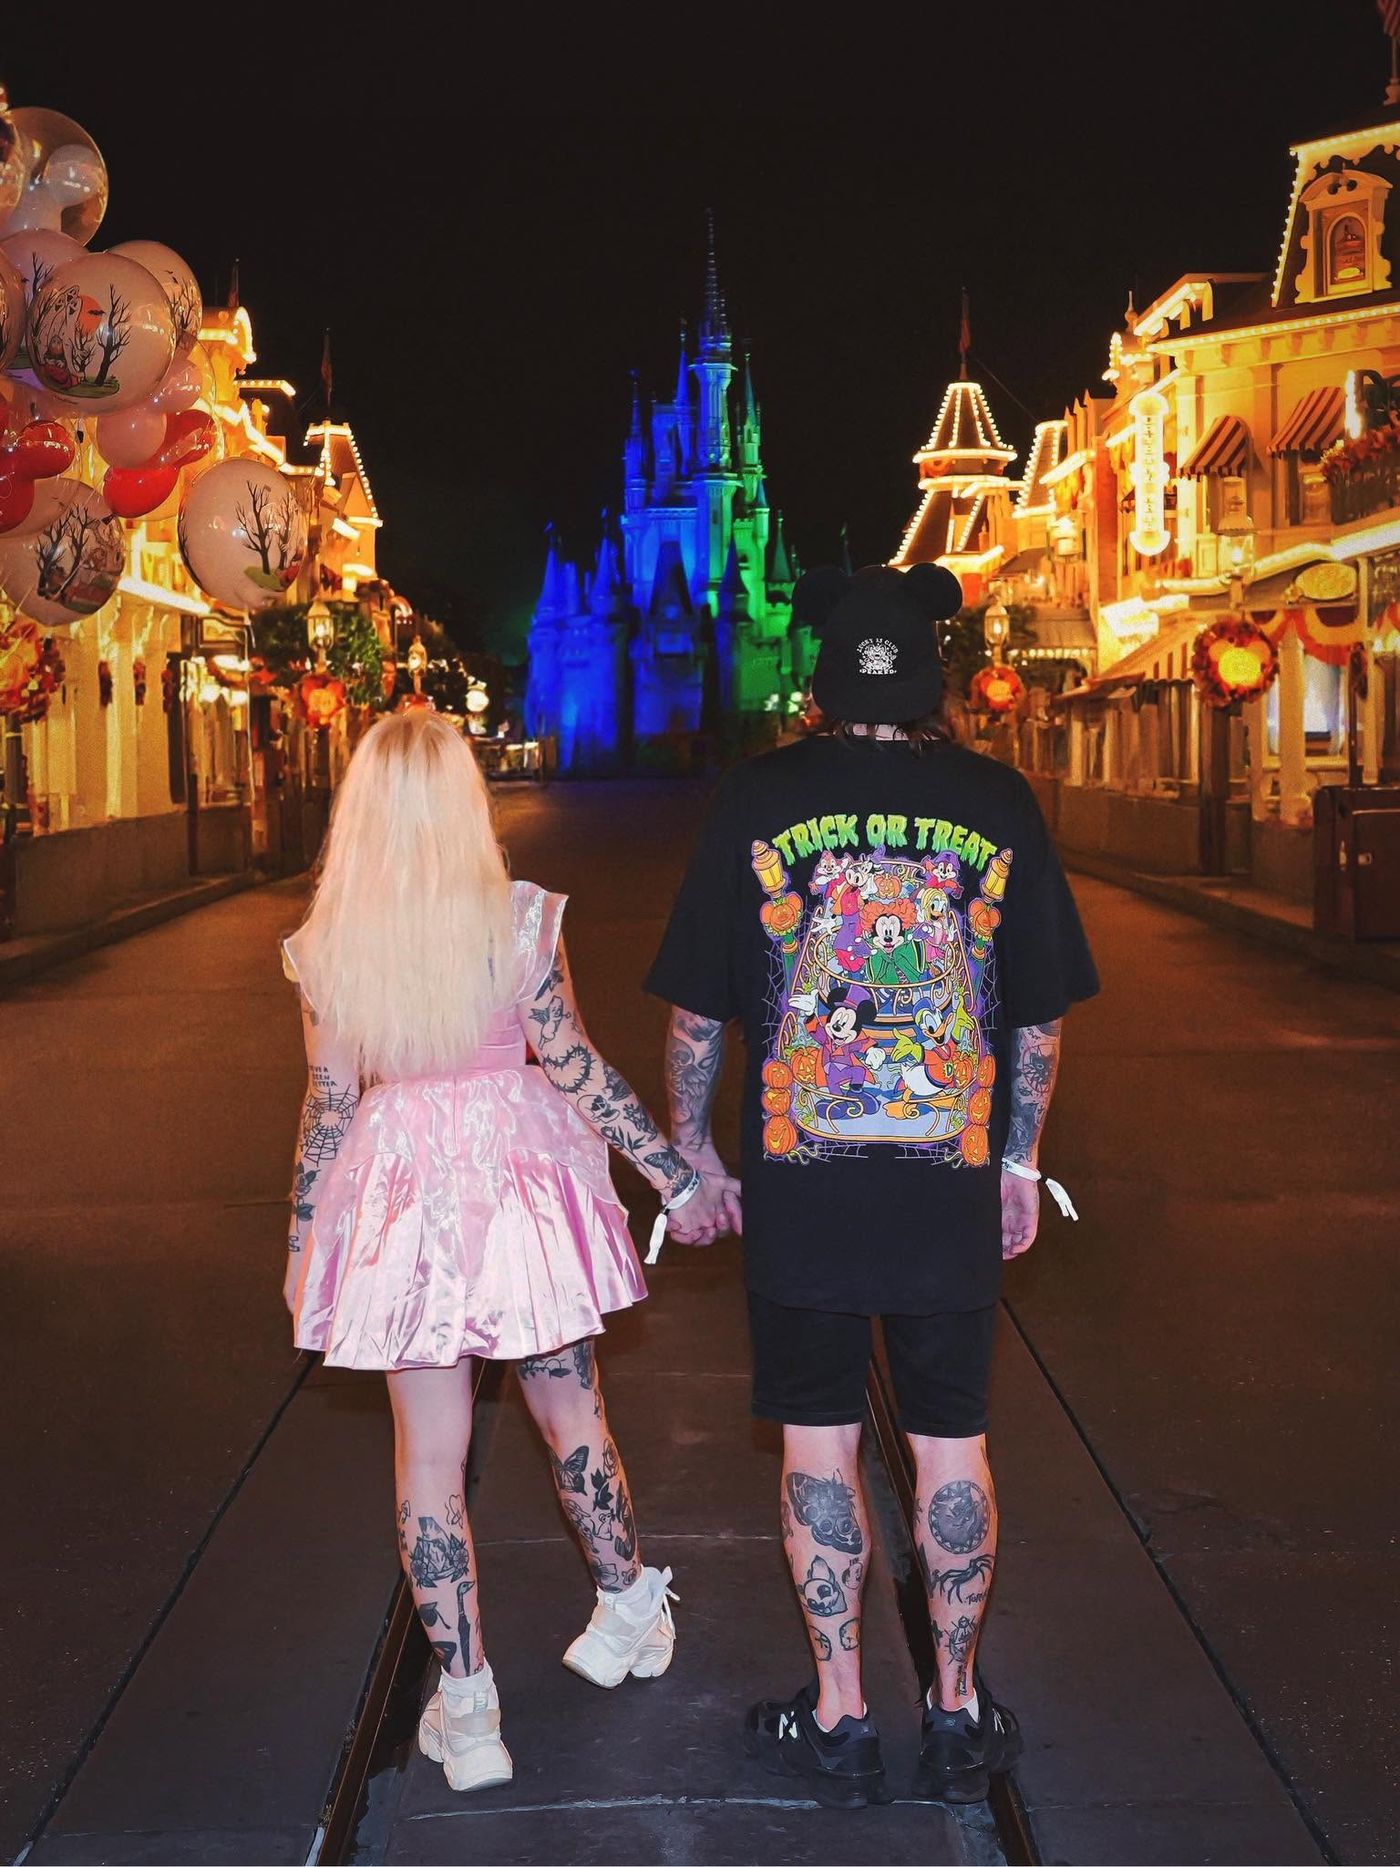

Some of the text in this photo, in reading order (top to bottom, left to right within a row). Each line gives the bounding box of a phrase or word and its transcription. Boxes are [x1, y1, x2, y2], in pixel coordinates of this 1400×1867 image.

[772, 813, 998, 872] TRICK OR TREAT
